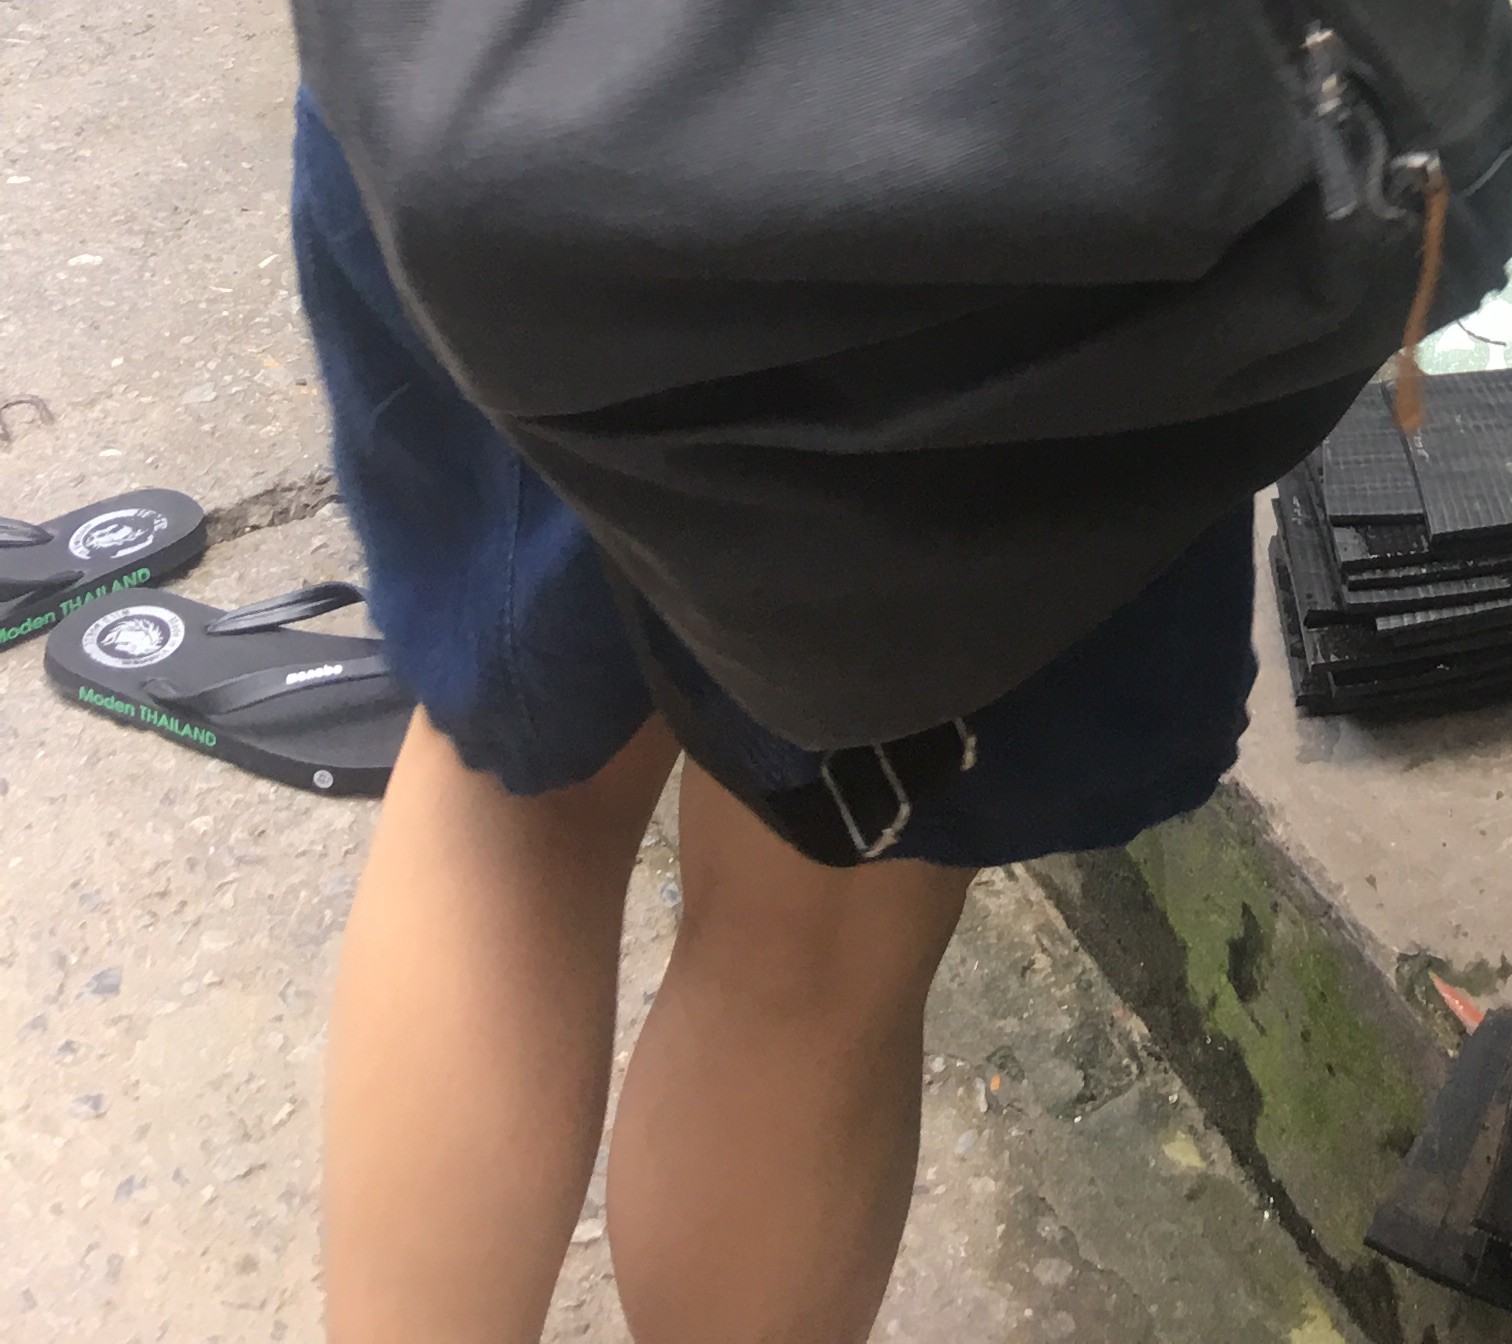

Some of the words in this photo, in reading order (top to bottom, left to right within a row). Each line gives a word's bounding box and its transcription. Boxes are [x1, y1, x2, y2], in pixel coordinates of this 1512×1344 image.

[58, 566, 152, 616] THAILAND
[77, 686, 137, 718] Moden
[139, 703, 217, 749] THAILAND
